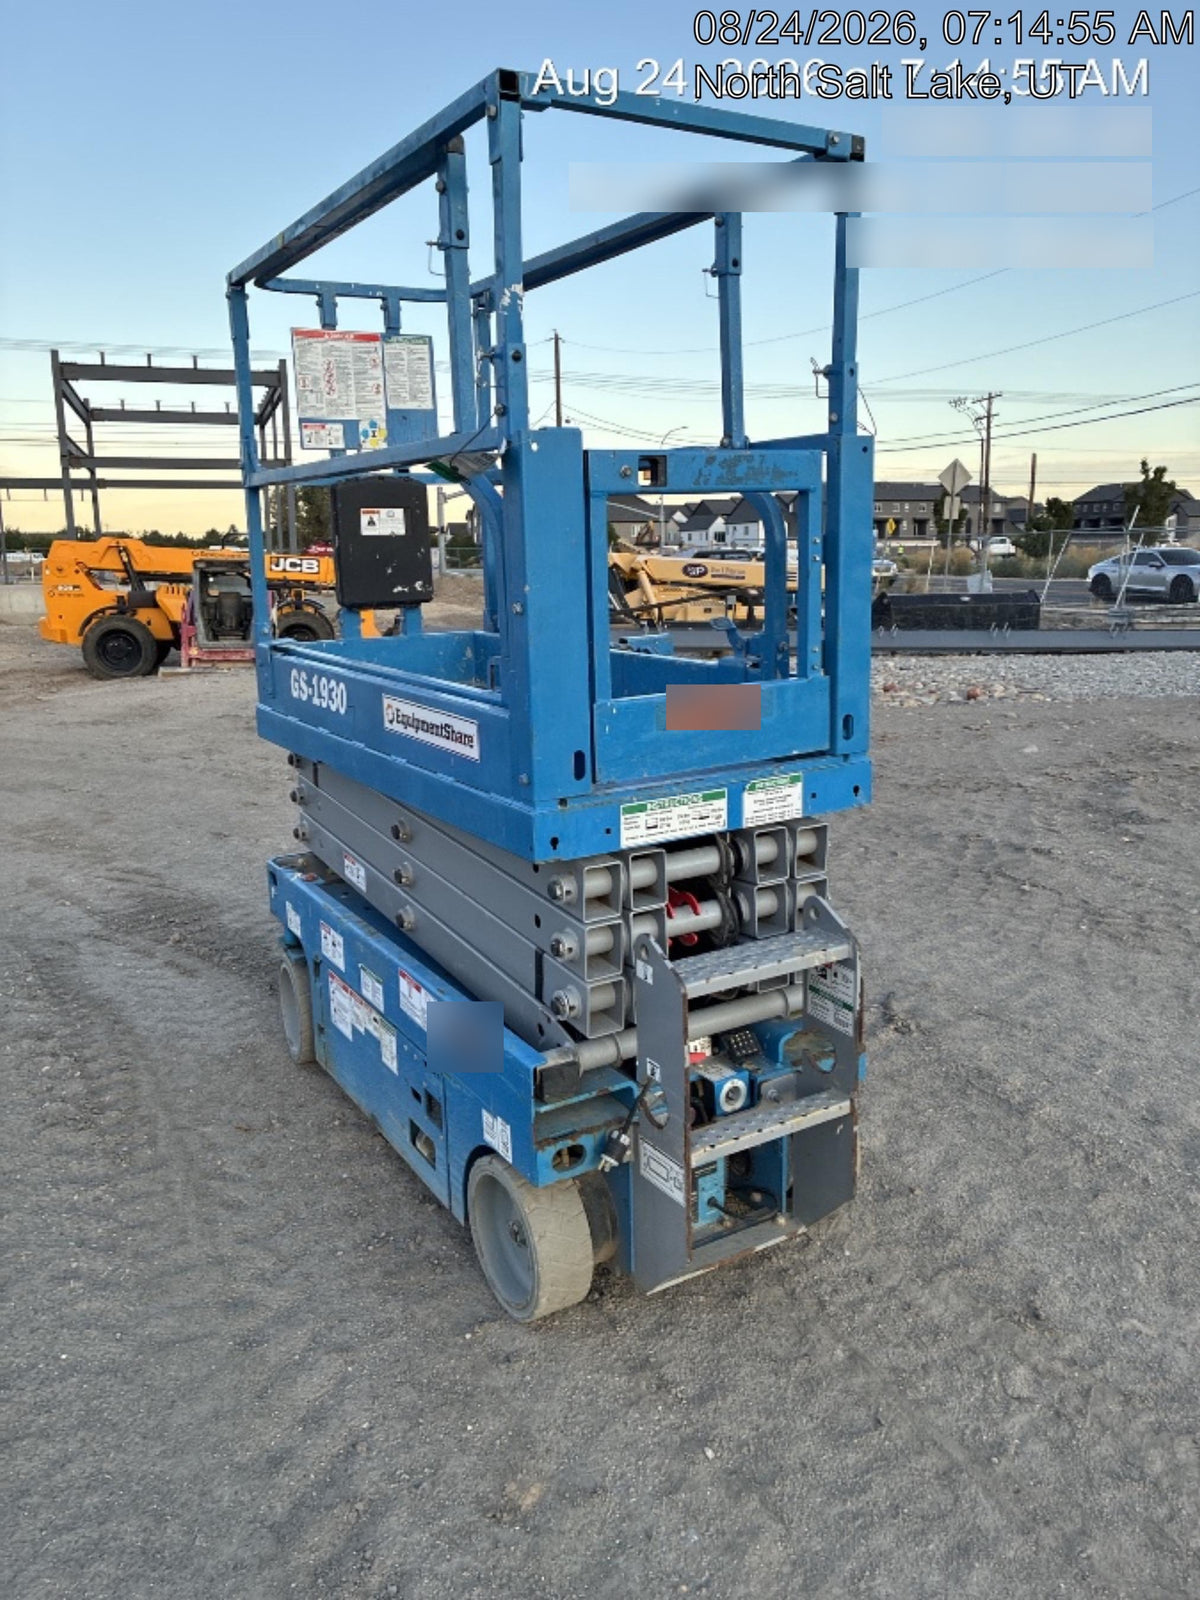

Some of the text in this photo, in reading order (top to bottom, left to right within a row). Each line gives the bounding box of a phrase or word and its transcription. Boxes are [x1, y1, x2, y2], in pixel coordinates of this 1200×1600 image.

[271, 557, 320, 574] JCB
[290, 668, 347, 716] GS-1930
[394, 706, 475, 749] EquipmentShare
